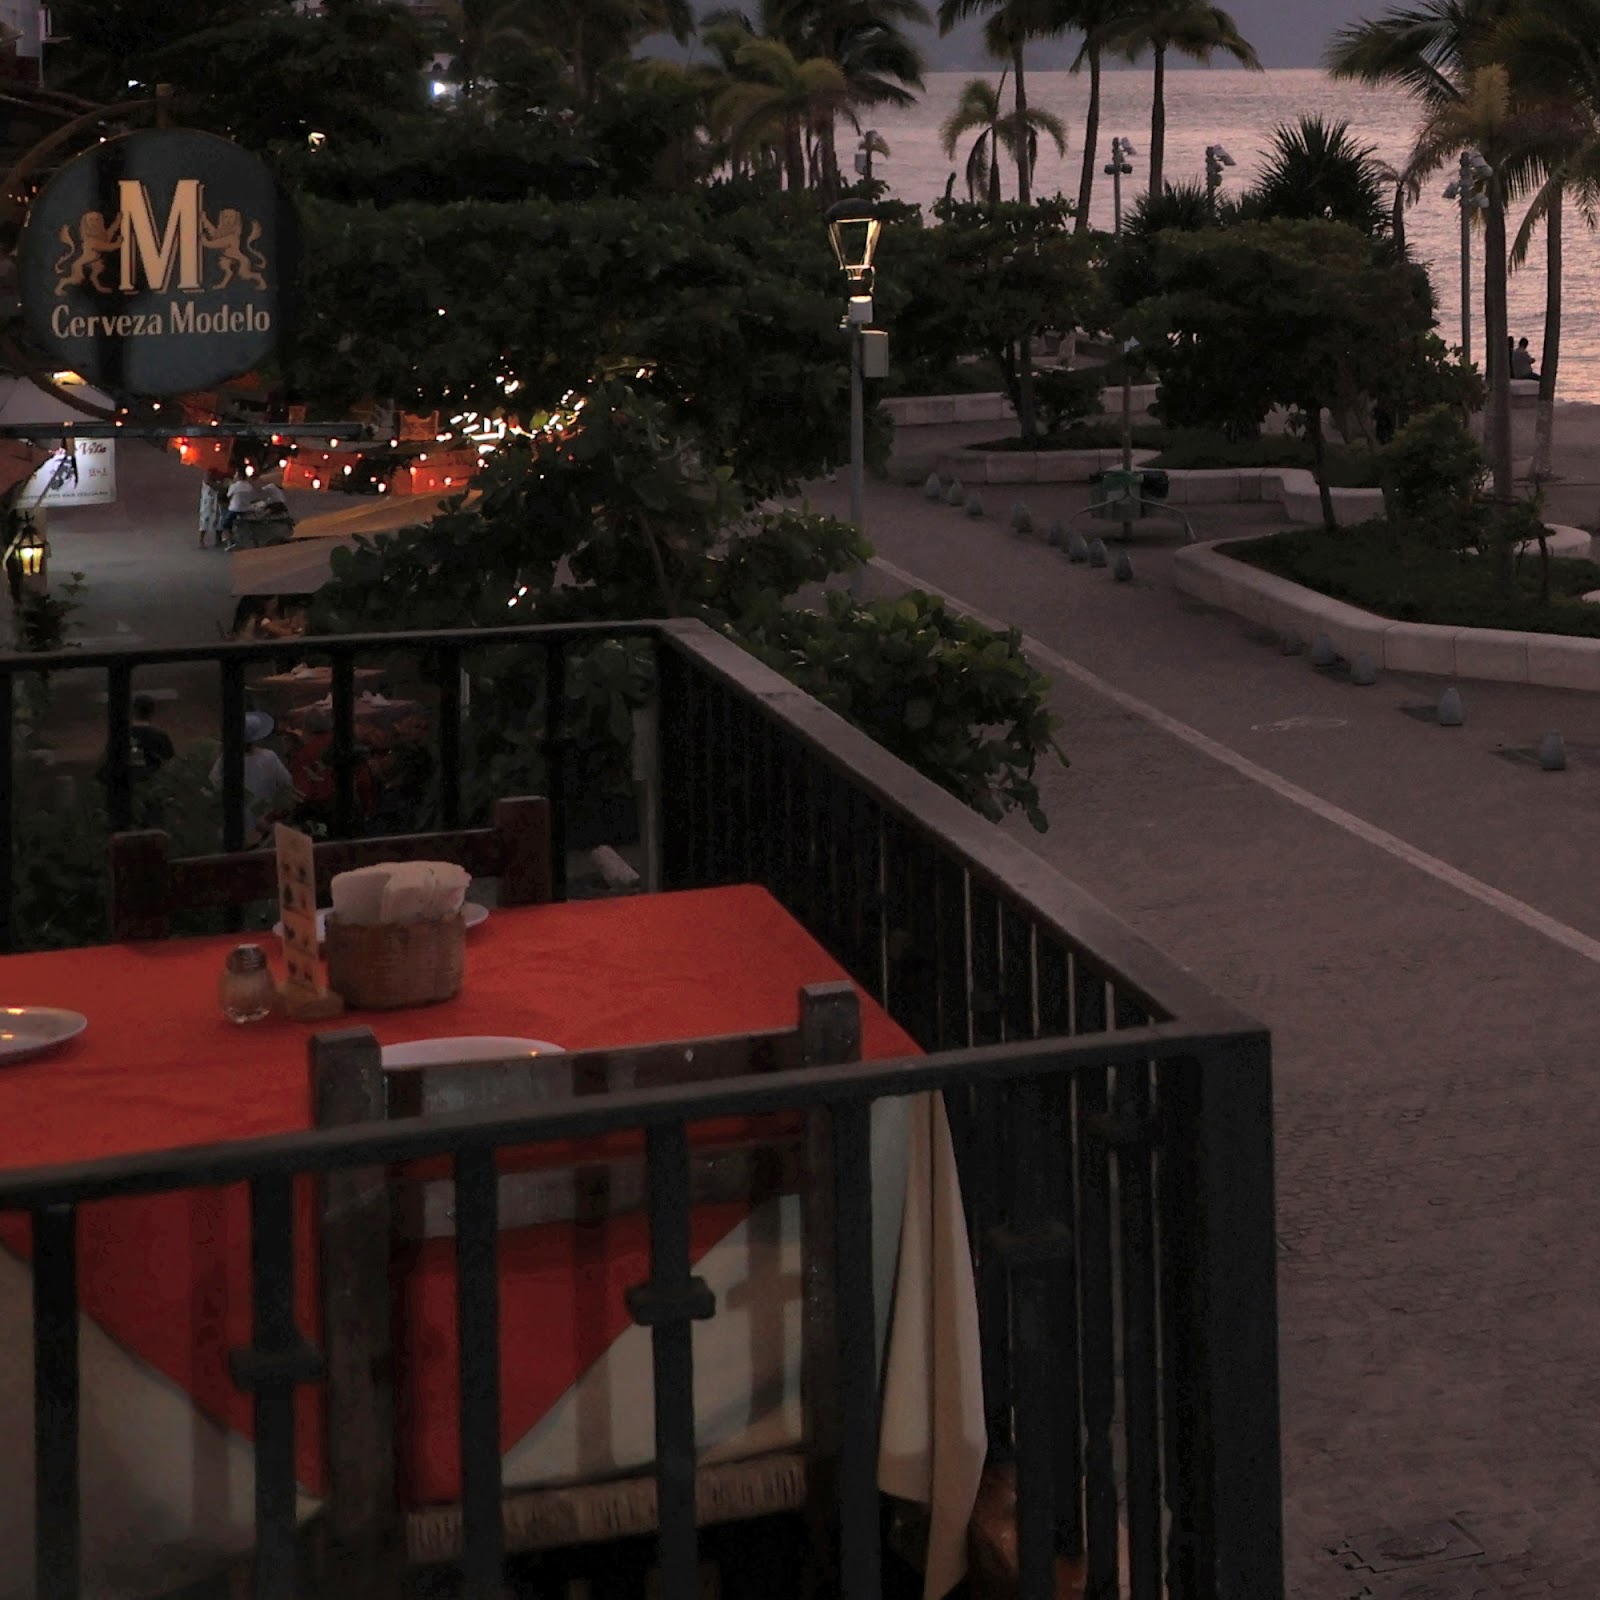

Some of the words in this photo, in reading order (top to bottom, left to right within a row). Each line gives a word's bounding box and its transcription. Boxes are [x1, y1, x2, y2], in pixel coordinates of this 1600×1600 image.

[118, 179, 204, 294] M
[51, 303, 162, 339] Cerveza
[170, 300, 270, 335] Modelo
